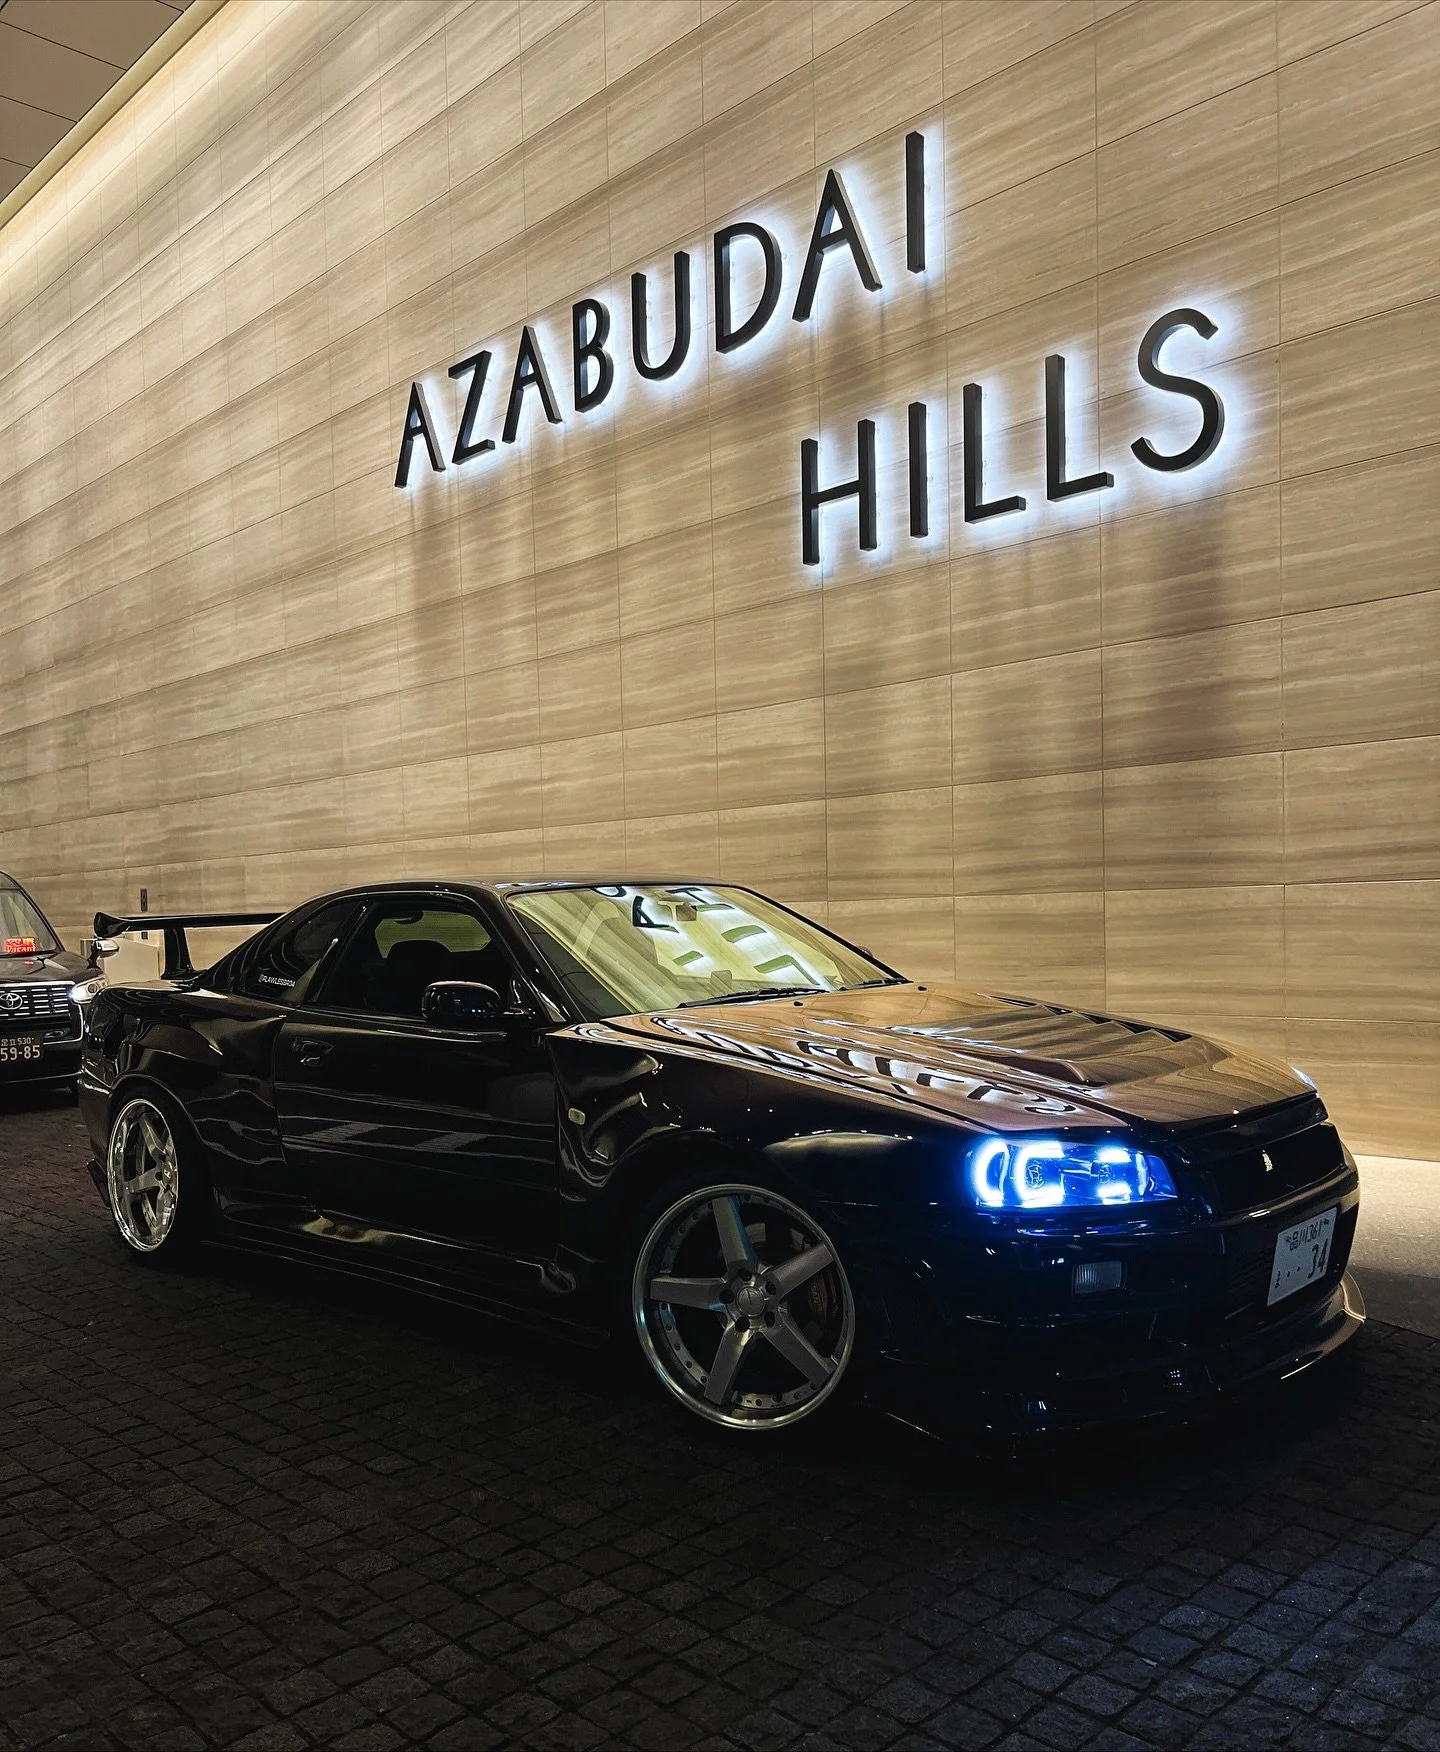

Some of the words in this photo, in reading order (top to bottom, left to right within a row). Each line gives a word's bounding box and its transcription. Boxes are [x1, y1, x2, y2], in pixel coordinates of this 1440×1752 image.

[395, 131, 926, 489] AZABUDAI
[801, 308, 1225, 566] HILLS
[0, 1045, 41, 1061] 59-85
